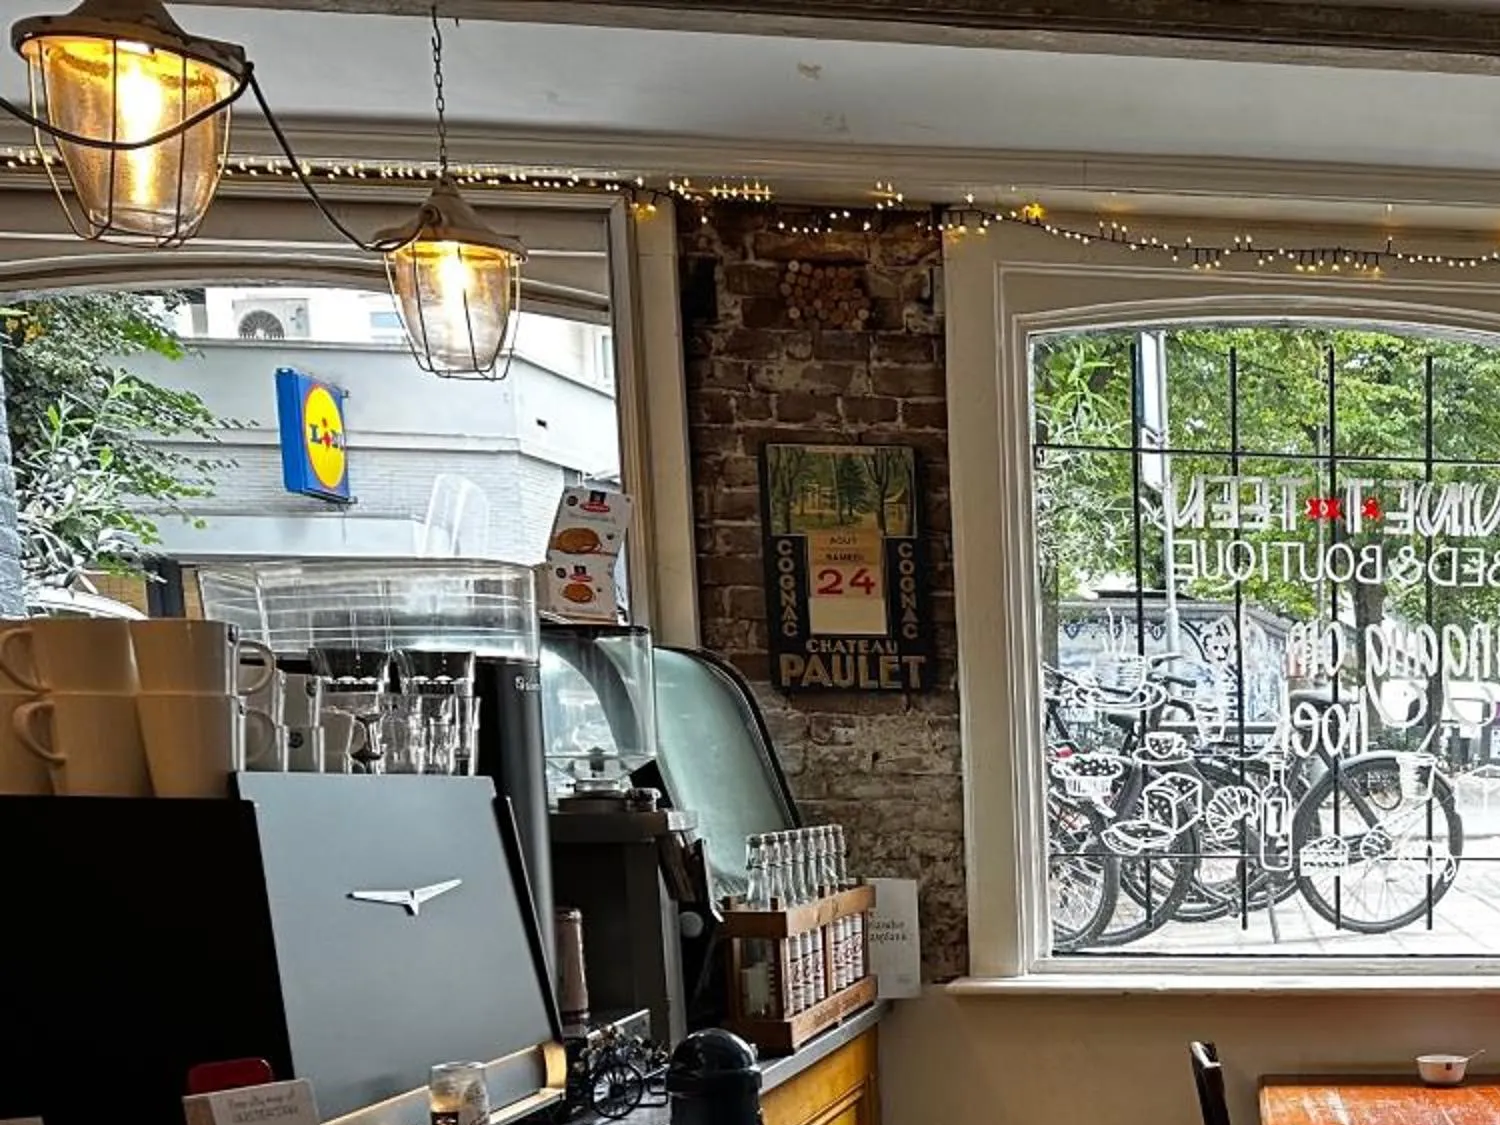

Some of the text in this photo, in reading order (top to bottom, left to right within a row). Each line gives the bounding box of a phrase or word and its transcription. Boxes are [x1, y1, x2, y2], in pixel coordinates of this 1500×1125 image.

[777, 539, 798, 637] COGNAC
[817, 568, 876, 595] 24
[898, 542, 919, 639] COGNAC
[805, 639, 899, 653] CHATEAU
[779, 654, 927, 689] PAULET
